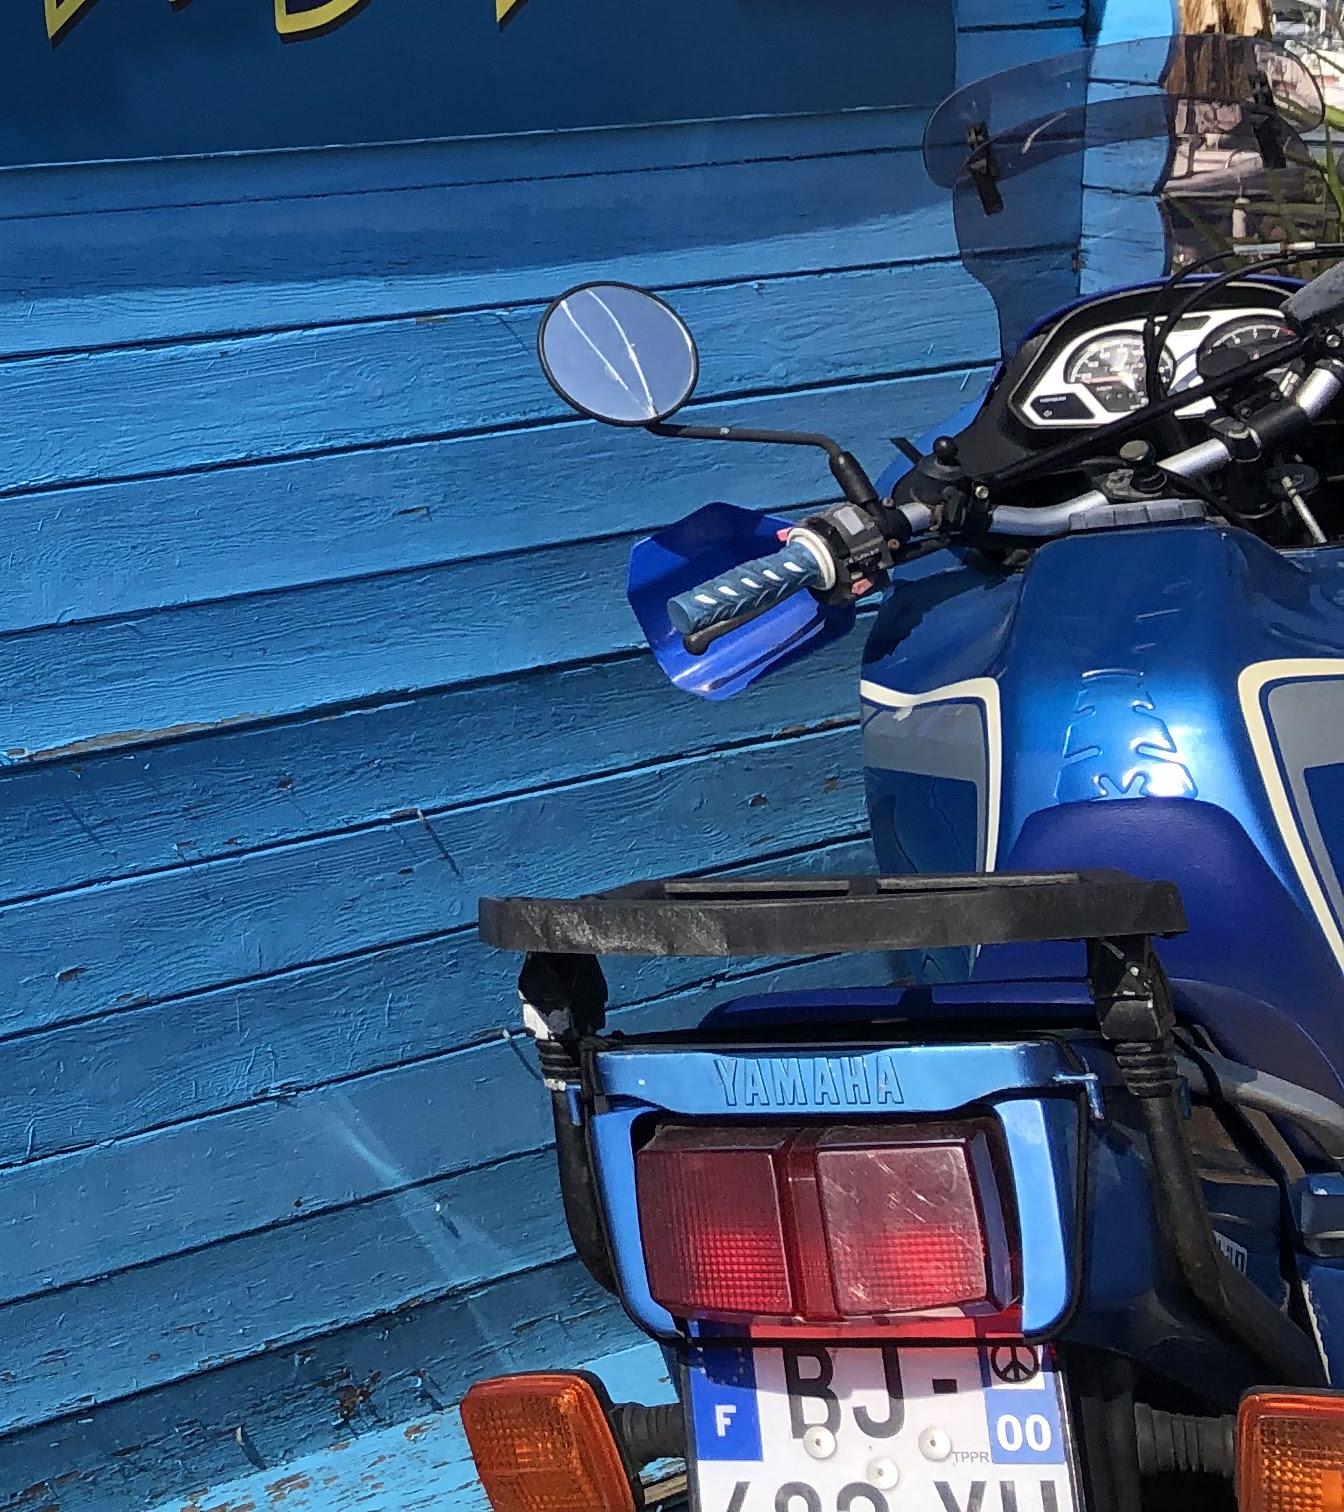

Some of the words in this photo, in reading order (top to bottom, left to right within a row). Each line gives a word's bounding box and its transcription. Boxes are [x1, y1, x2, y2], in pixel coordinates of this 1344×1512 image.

[713, 1055, 904, 1107] YAMAHA
[715, 1404, 737, 1437] F
[996, 1413, 1052, 1452] 00
